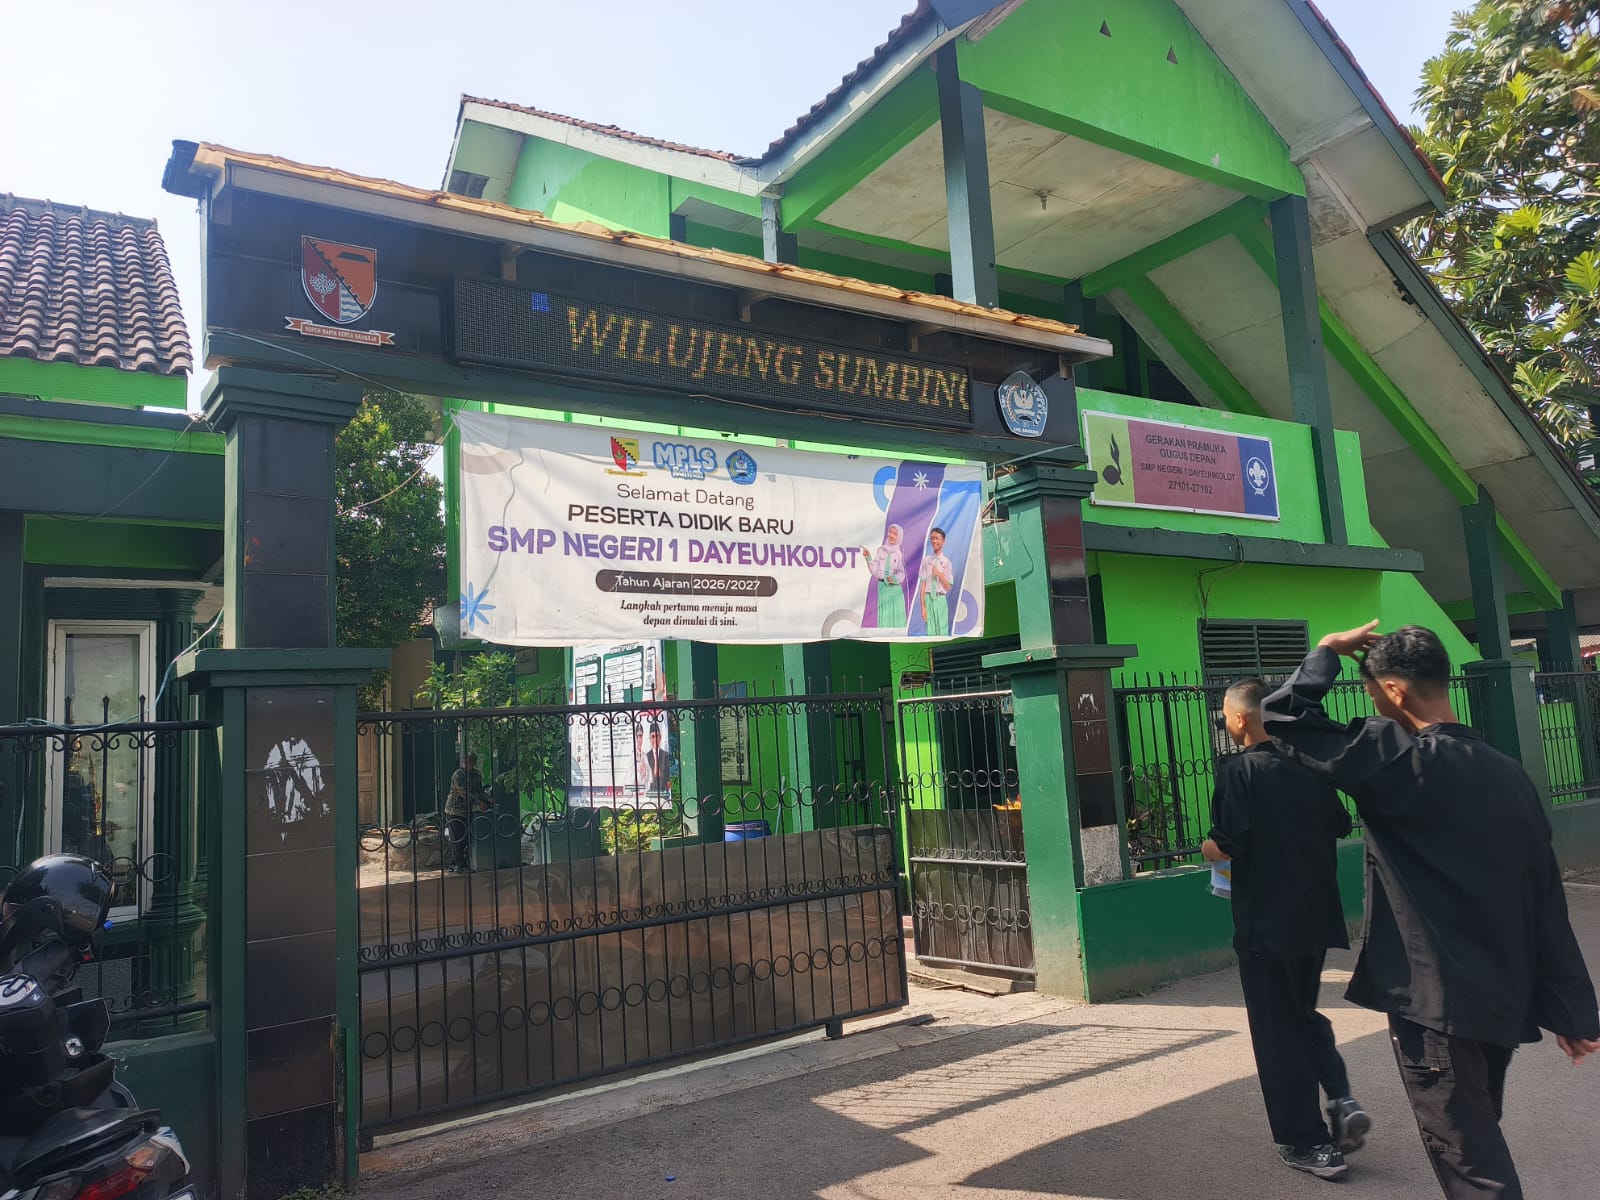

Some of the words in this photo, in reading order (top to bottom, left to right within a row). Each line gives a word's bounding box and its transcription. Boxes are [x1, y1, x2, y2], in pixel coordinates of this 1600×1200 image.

[567, 307, 802, 385] WILUJENG
[1145, 434, 1186, 448] GERAKAN
[1187, 440, 1227, 454] PRAMUKA
[653, 442, 717, 473] MPLS
[1160, 448, 1188, 460] GUGUS
[1190, 453, 1216, 464] DEPAN
[1140, 463, 1155, 472] SMP
[1156, 464, 1182, 474] NEGERI
[1189, 469, 1236, 481] DAYEUHKOLOT
[1168, 480, 1214, 494] 27101-27102
[617, 483, 690, 503] Selamat
[696, 489, 754, 511] Datang
[568, 504, 674, 528] PESERTA
[679, 512, 733, 532] DIDIK
[739, 517, 794, 535] BARU
[488, 525, 556, 555] SMP
[563, 531, 663, 562] NEGERI
[668, 538, 678, 562] 1
[688, 539, 861, 569] DAYEUHKOLOT
[615, 575, 649, 587] Tahun
[653, 577, 690, 591] Ajaran
[693, 578, 760, 591] 2026/2027
[620, 599, 661, 613] Langkah
[663, 602, 699, 613] pertama
[702, 603, 733, 614] menuju
[735, 605, 757, 613] masa
[643, 614, 671, 627] depan
[673, 615, 707, 626] dimulai
[710, 616, 718, 626] di
[720, 616, 738, 626] sini.
